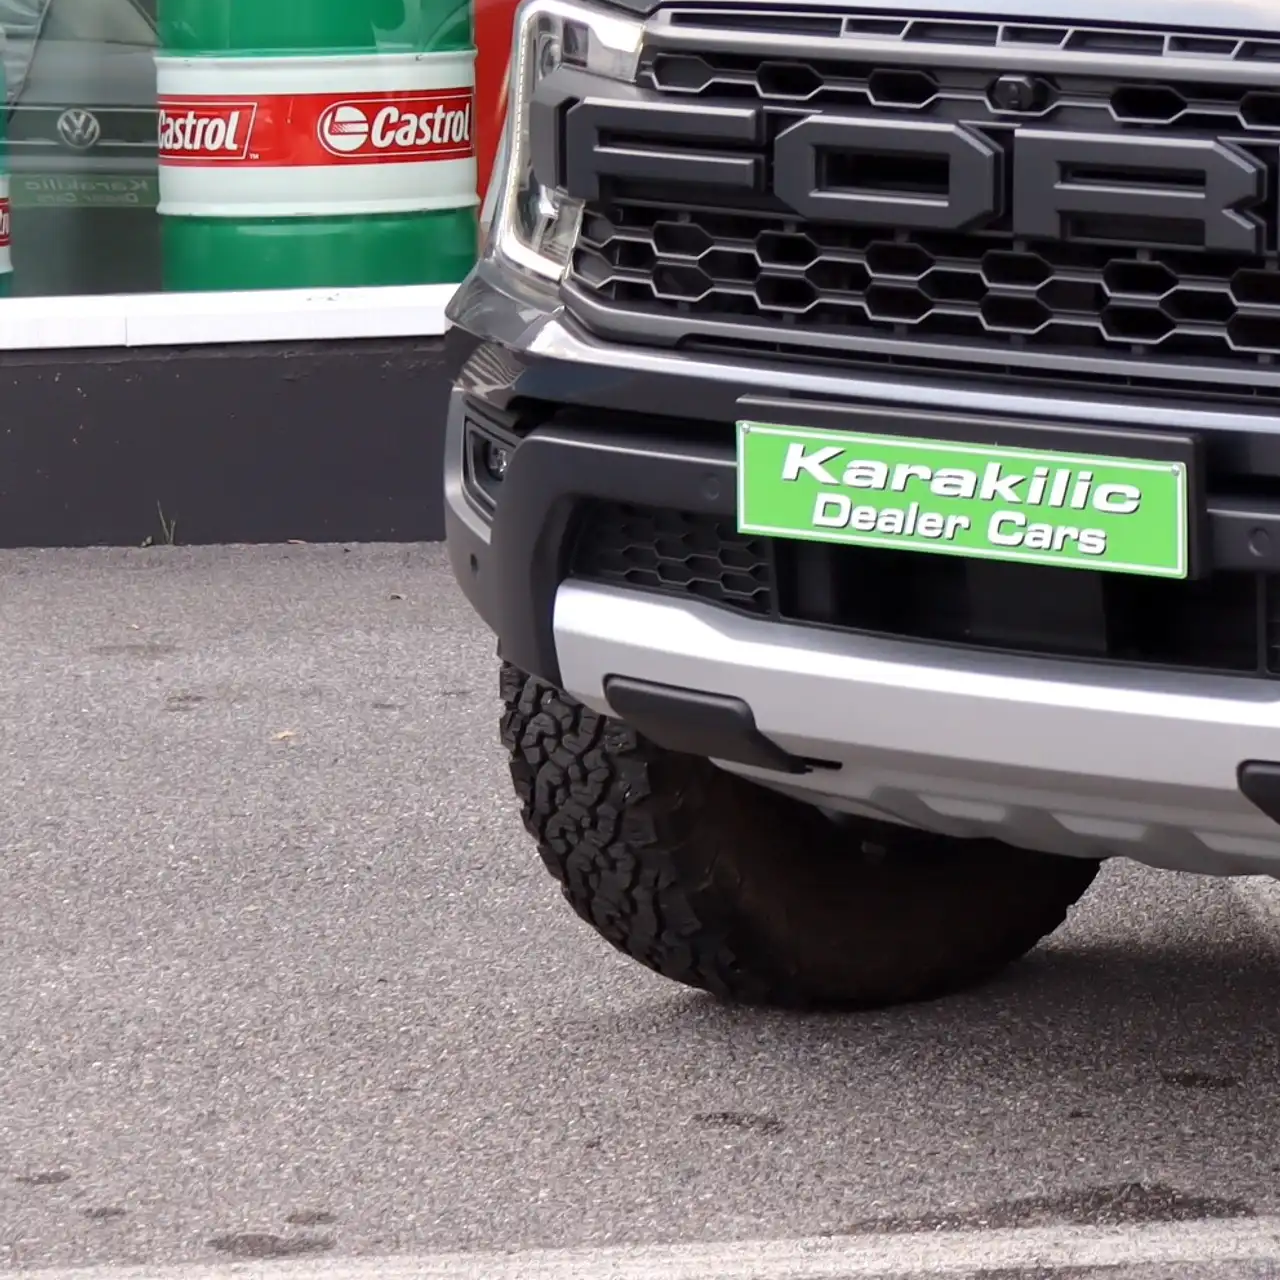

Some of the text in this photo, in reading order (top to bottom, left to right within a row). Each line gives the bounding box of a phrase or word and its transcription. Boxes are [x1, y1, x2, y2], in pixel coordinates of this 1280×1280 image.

[158, 109, 240, 151] Castrol
[371, 103, 470, 149] Castrol
[781, 442, 1142, 515] Karakilic
[811, 492, 1107, 555] Dealer Cars
